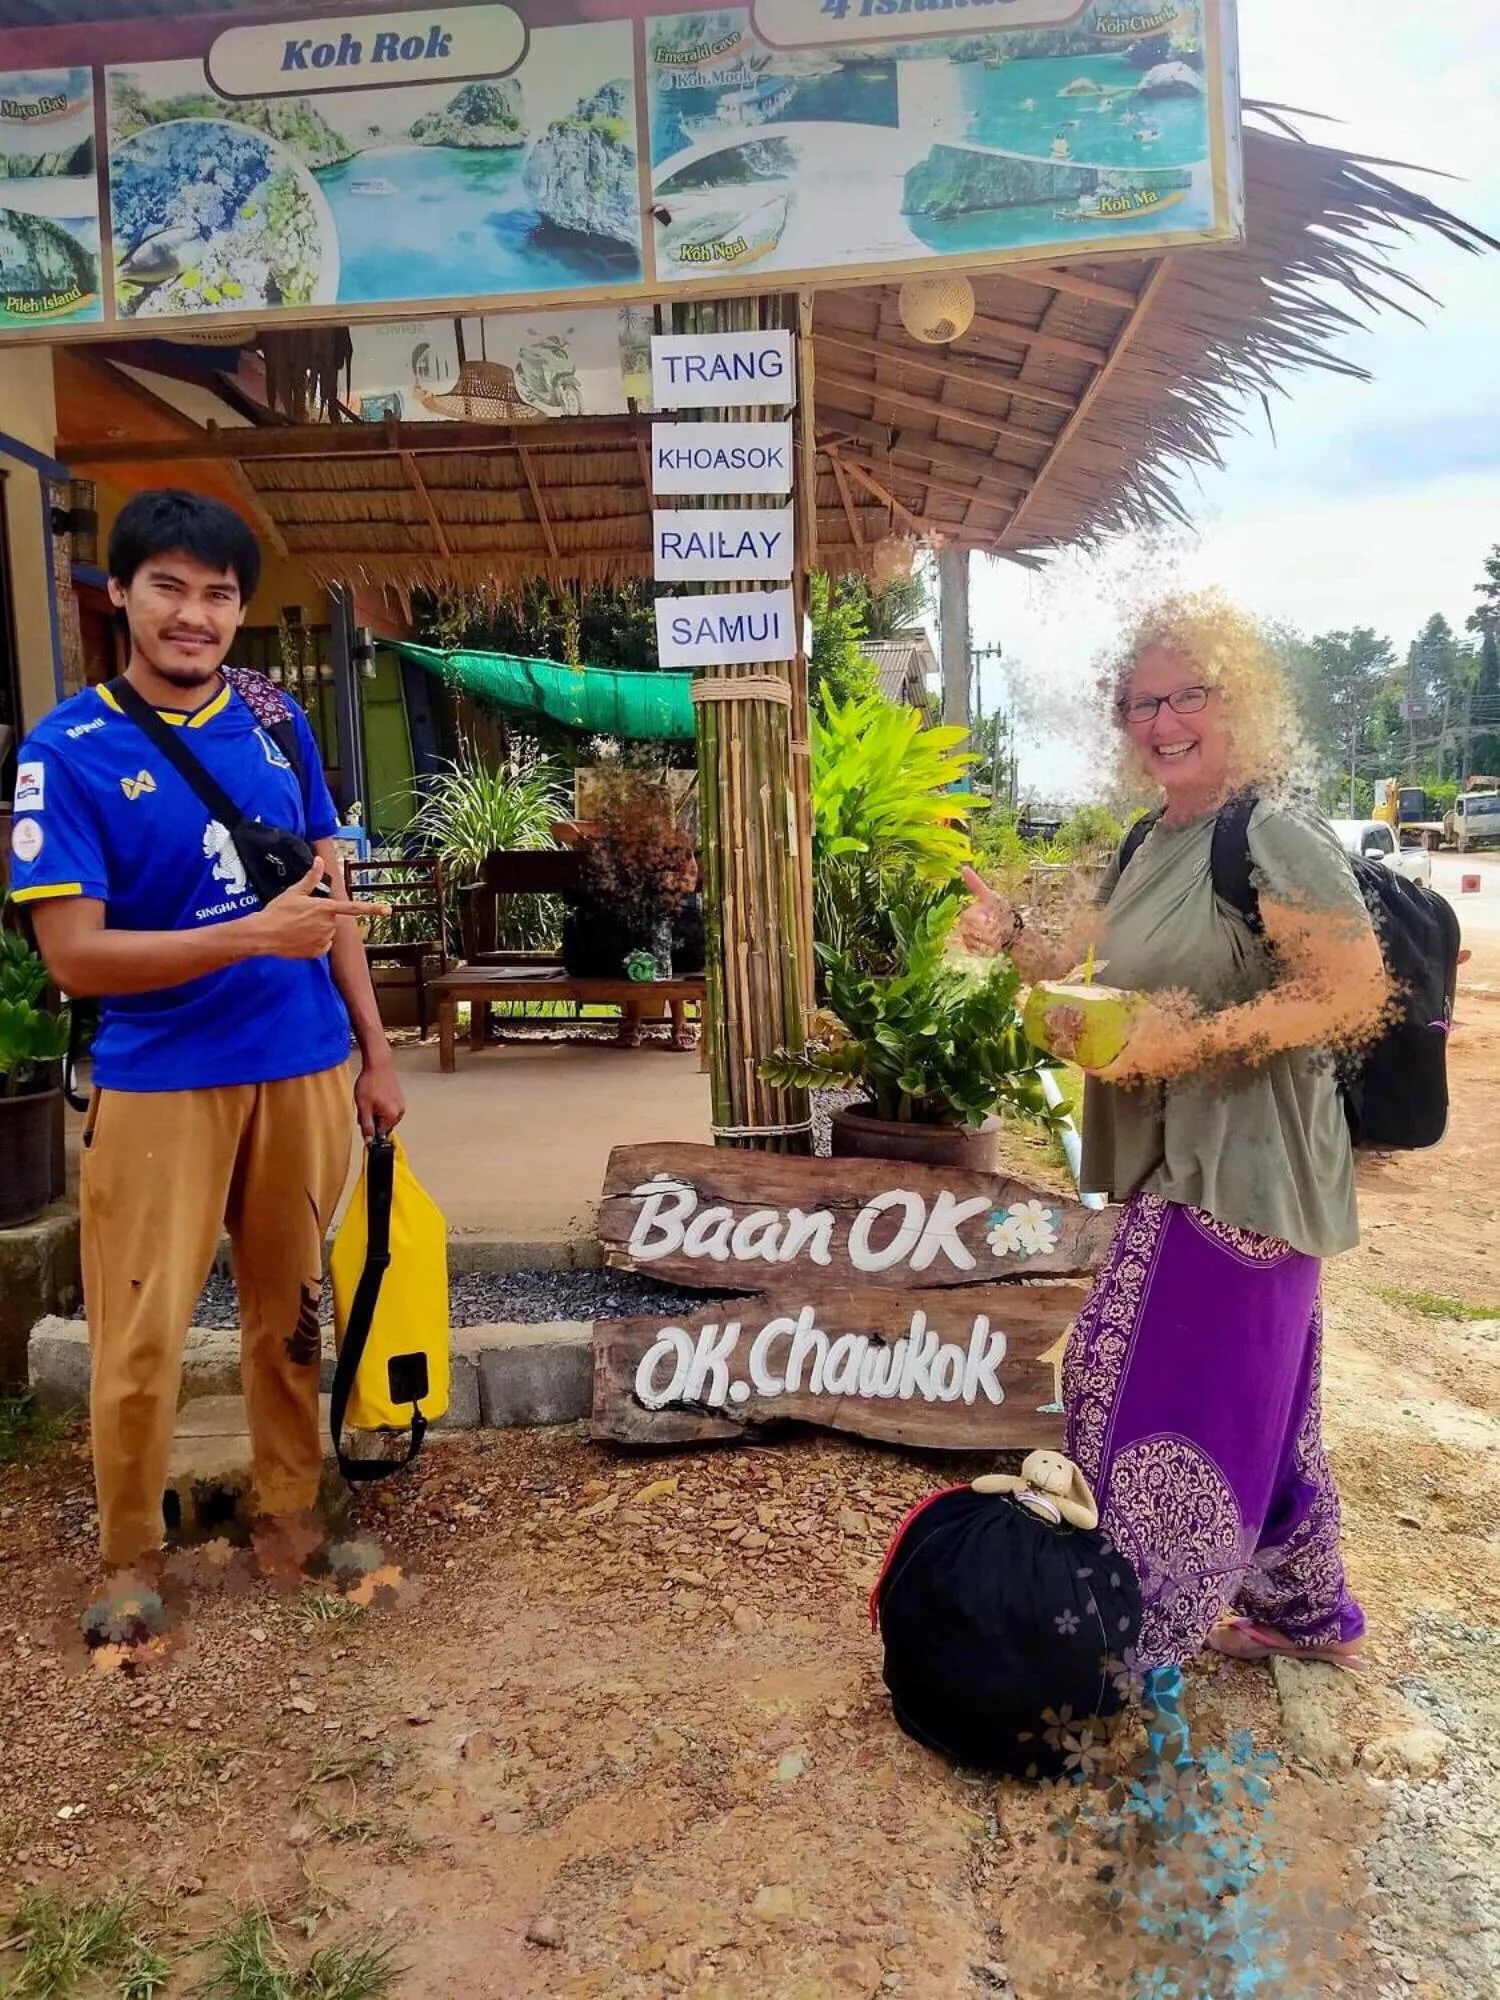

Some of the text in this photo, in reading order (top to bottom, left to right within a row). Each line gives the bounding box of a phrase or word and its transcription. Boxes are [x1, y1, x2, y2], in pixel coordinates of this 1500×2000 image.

[1095, 15, 1126, 34] Koh
[280, 25, 453, 72] Koh Rok
[655, 32, 741, 63] Emerald cave
[1, 94, 67, 120] Maya Bay
[1100, 190, 1158, 212] Koh Ma
[680, 235, 748, 261] Koh Ngai
[6, 284, 83, 313] Pileh Island
[661, 349, 783, 384] TRANG
[659, 447, 784, 469] KHOASOK
[661, 531, 781, 559] RAILAY
[672, 612, 779, 645] SAMUI
[195, 900, 238, 920] SINGHA
[627, 1172, 993, 1272] Baan OK
